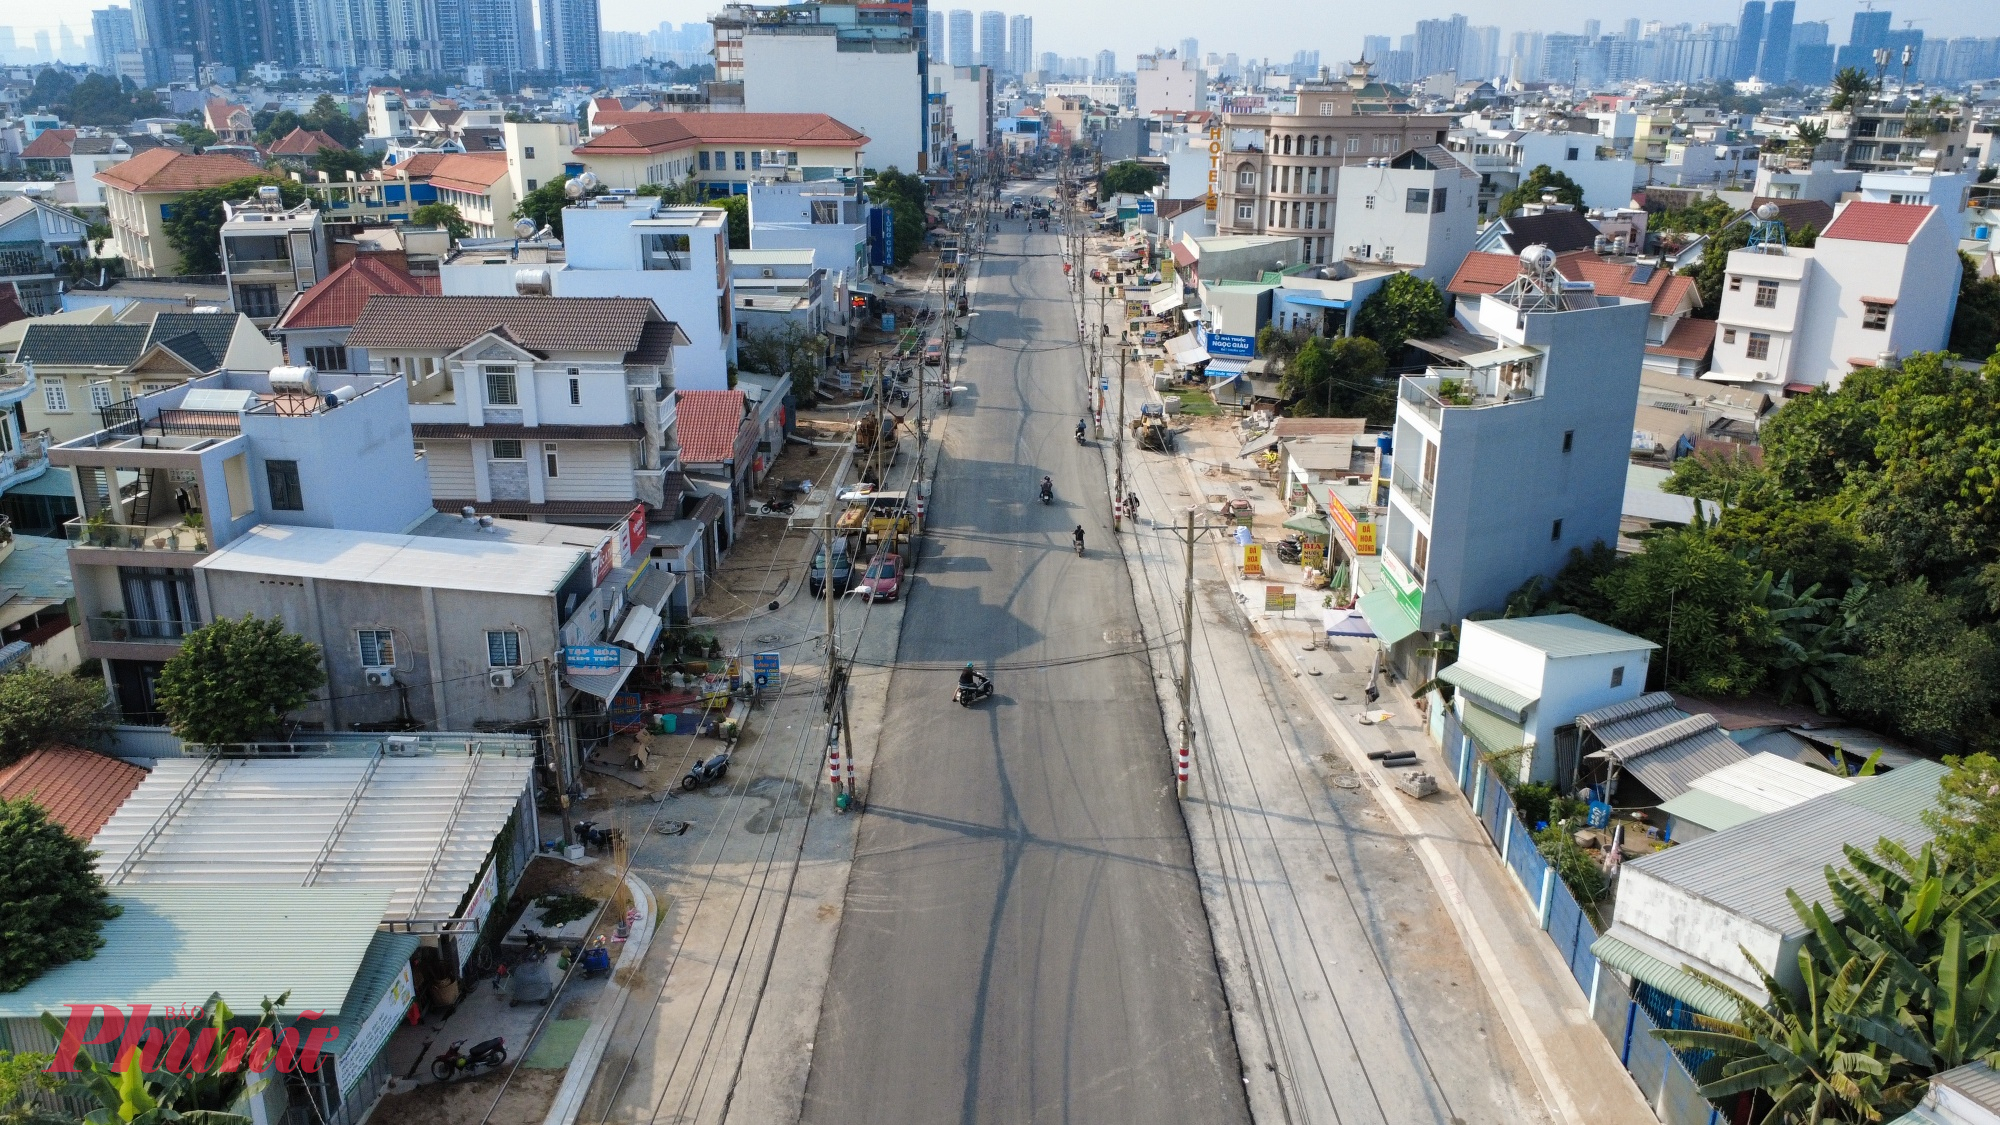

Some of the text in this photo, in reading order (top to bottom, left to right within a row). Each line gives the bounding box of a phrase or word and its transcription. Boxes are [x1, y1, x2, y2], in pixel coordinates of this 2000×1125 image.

[1208, 127, 1221, 197] HOTEL
[1362, 524, 1371, 533] ĐÁ
[567, 648, 590, 656] TẠP
